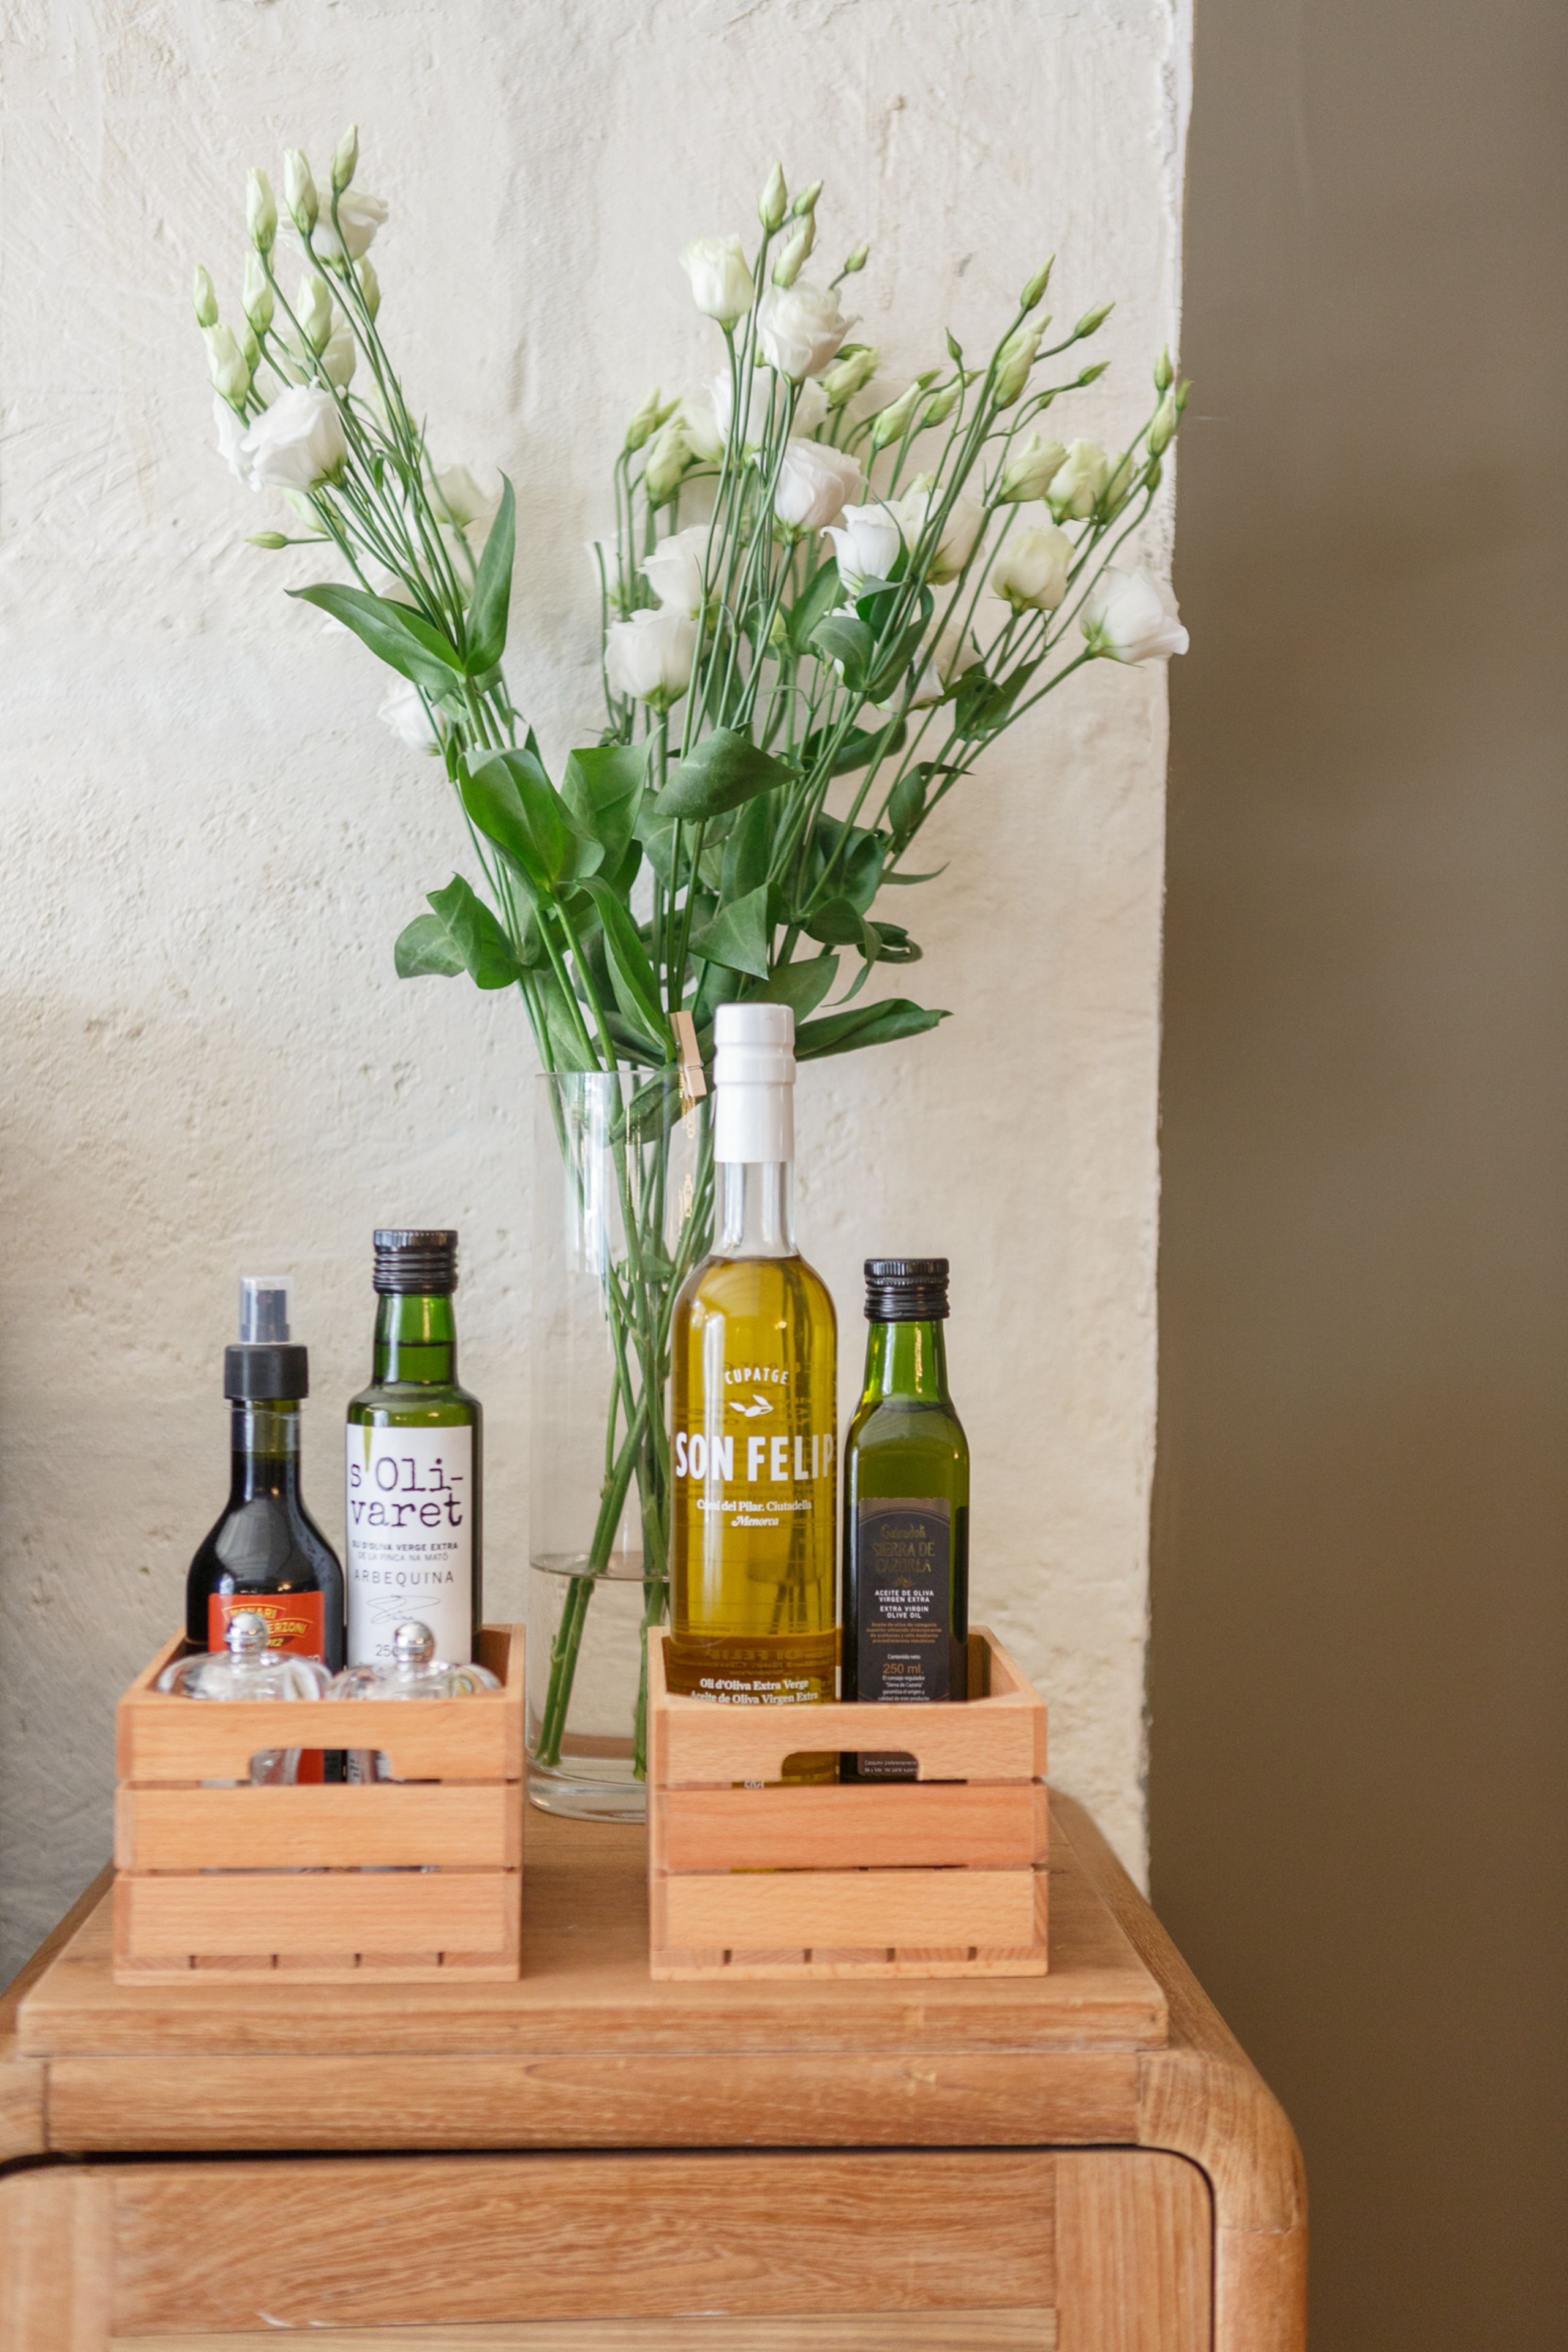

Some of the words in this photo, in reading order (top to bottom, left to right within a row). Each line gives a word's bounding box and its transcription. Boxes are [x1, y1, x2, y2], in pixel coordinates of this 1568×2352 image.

[725, 1367, 788, 1385] CUPATGE
[676, 1431, 734, 1482] SON
[747, 1433, 834, 1482] FELIP
[350, 1492, 463, 1528] varet
[722, 1500, 736, 1511] del
[738, 1501, 764, 1512] Pilar.
[766, 1499, 812, 1512] Ciutadella
[731, 1515, 779, 1527] Menorca
[431, 1542, 459, 1551] EXTRA
[918, 1542, 935, 1557] DE
[380, 1553, 405, 1561] FINCA
[354, 1569, 454, 1587] ARBEQUINA
[883, 1663, 904, 1674] 250
[907, 1663, 924, 1674] ml.
[699, 1678, 714, 1689] Oli
[715, 1679, 752, 1691] d'Oliva
[753, 1680, 782, 1691] Extra
[782, 1679, 809, 1691] Verge
[690, 1691, 717, 1702] Aceite
[718, 1693, 731, 1703] de
[732, 1694, 760, 1705] Oliva
[761, 1694, 795, 1705] Virgen
[796, 1692, 819, 1702] Extra
